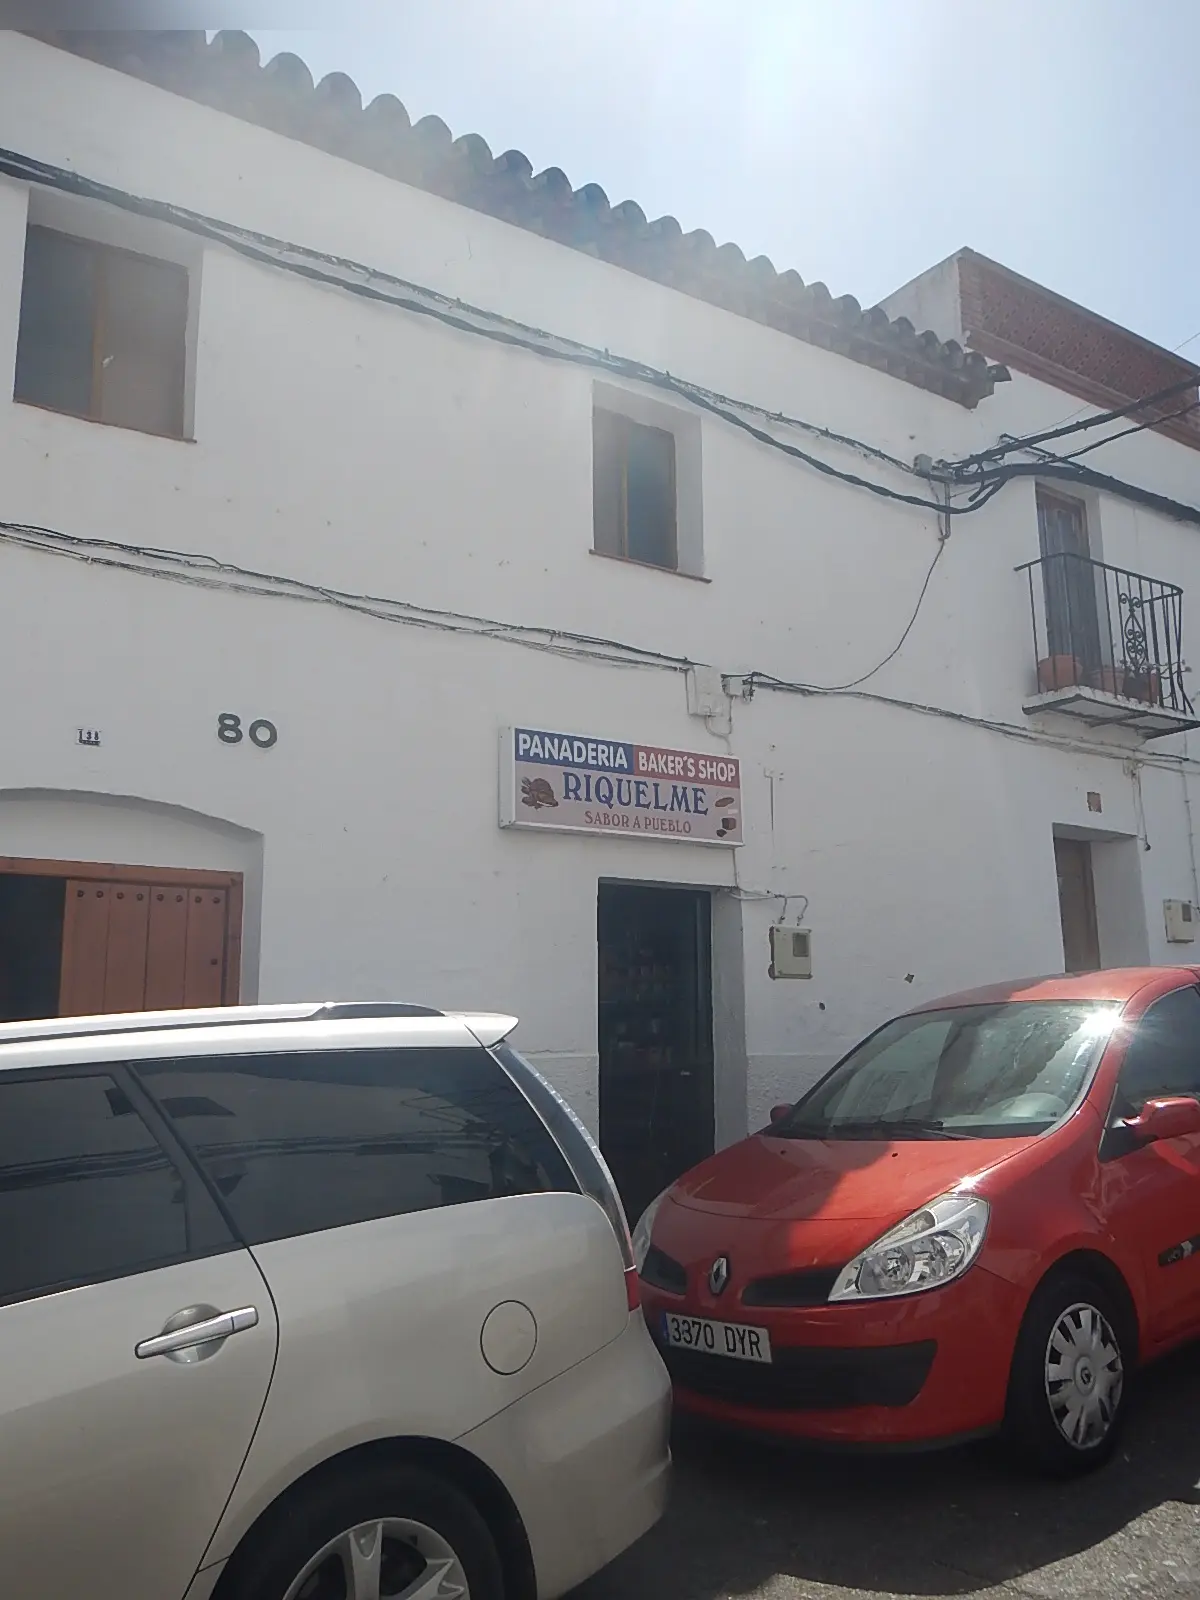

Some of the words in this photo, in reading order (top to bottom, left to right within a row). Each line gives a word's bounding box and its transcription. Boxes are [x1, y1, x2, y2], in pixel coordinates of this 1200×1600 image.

[218, 712, 278, 748] 80
[518, 733, 628, 769] PANADERIA
[698, 759, 736, 782] SHOP
[563, 771, 709, 815] RIQUELME
[584, 810, 629, 829] SABOR
[633, 817, 640, 829] A
[644, 818, 692, 834] PUEBLO
[671, 1317, 715, 1349] 3370
[724, 1325, 763, 1359] DYR
